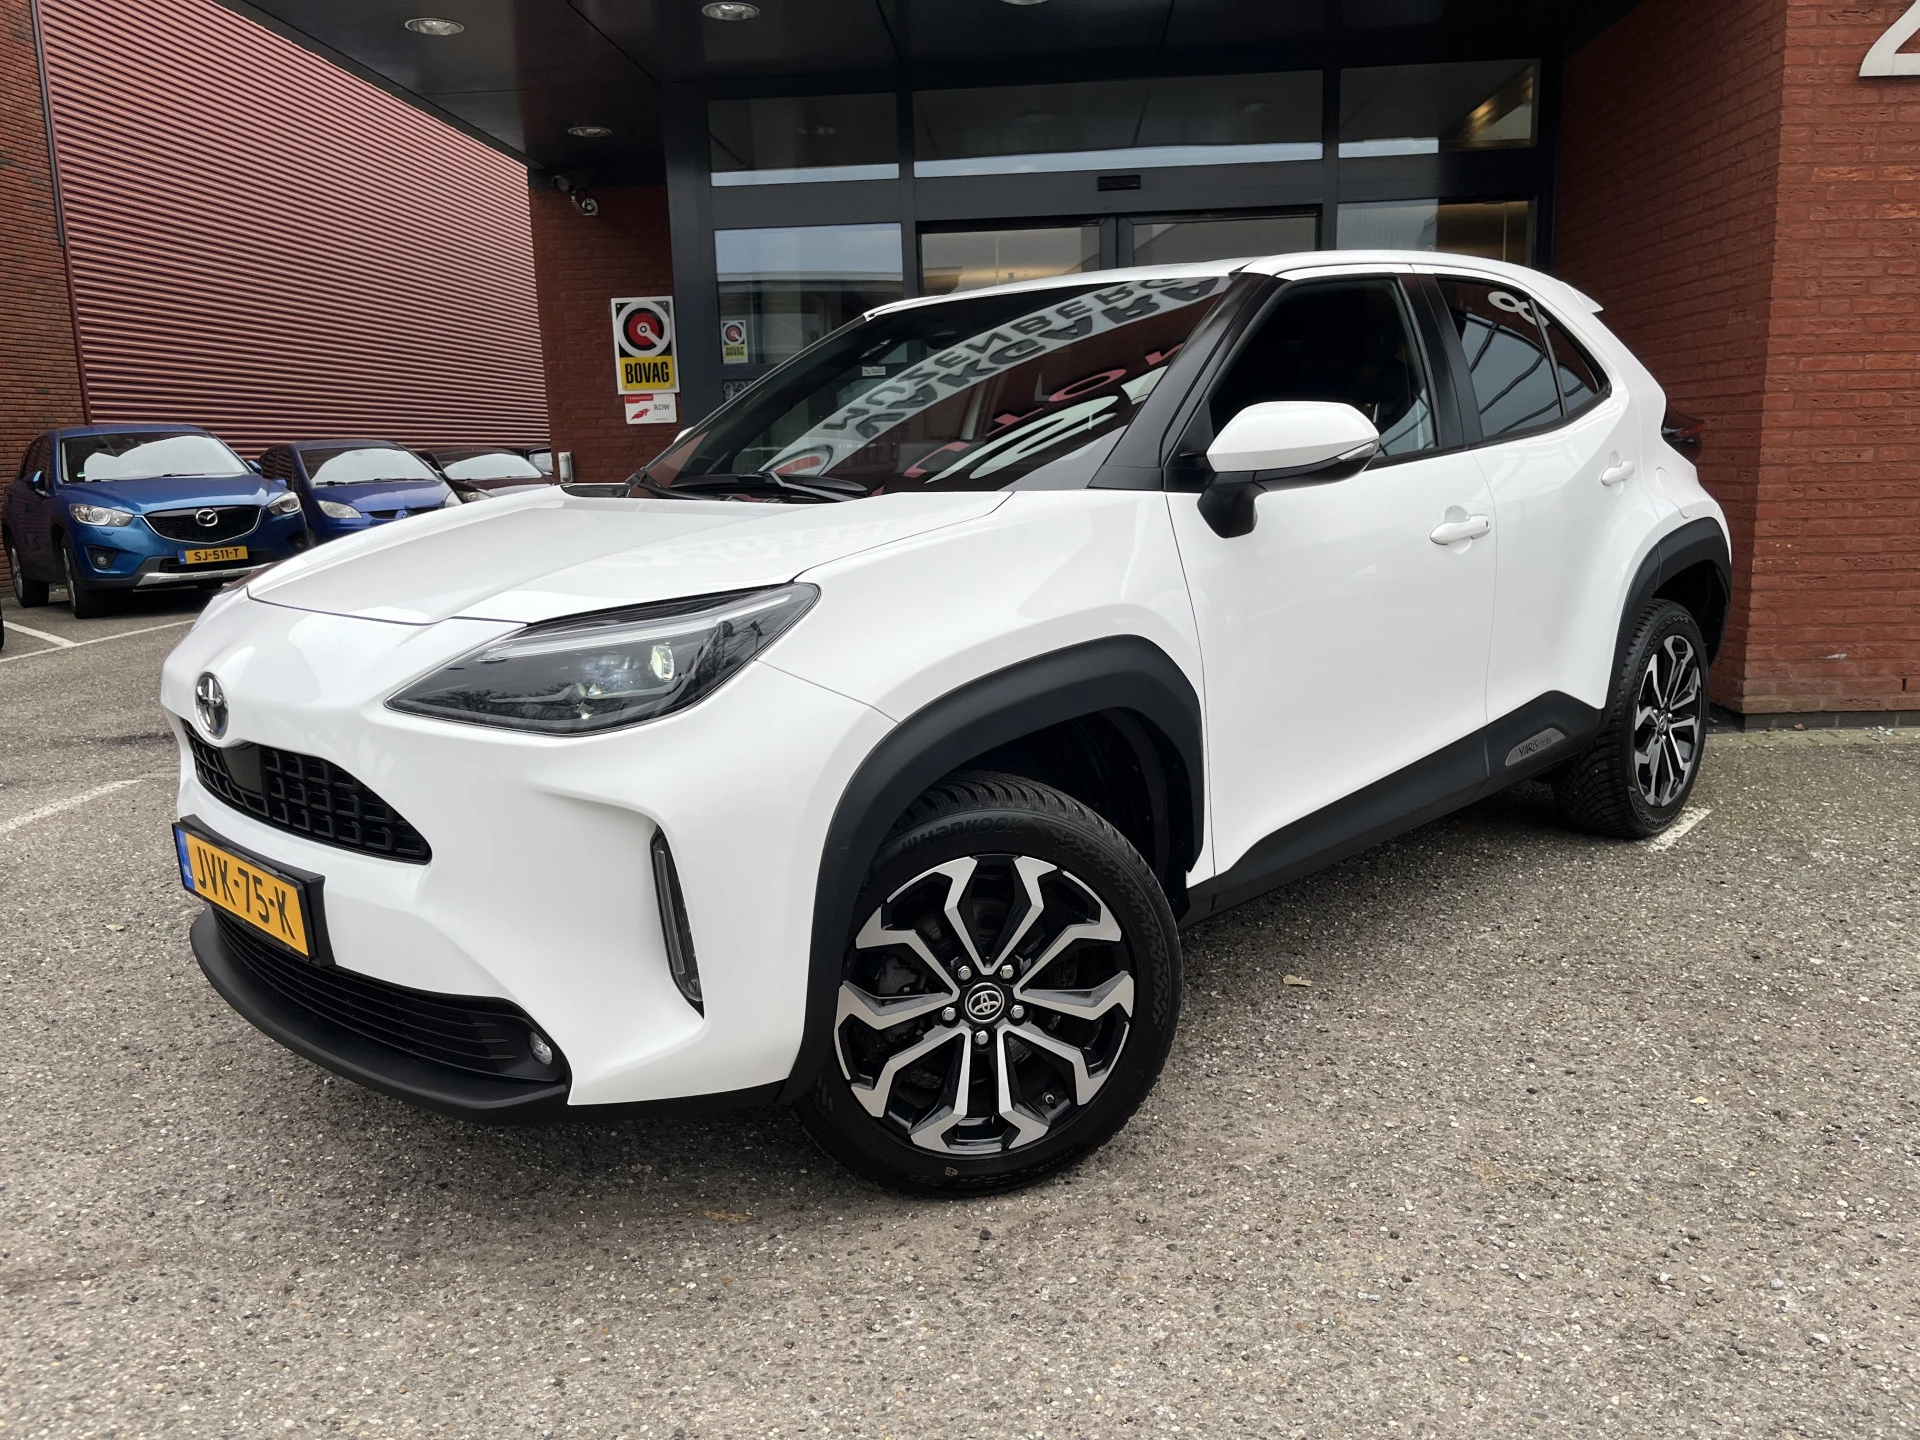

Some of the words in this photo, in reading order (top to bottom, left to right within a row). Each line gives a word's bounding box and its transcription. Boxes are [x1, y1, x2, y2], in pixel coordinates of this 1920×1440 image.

[624, 361, 670, 384] BOVAG
[653, 403, 670, 411] RDW
[194, 548, 239, 561] SJ-511-T
[1518, 739, 1539, 758] YARIS
[197, 845, 296, 940] JVK-75-K
